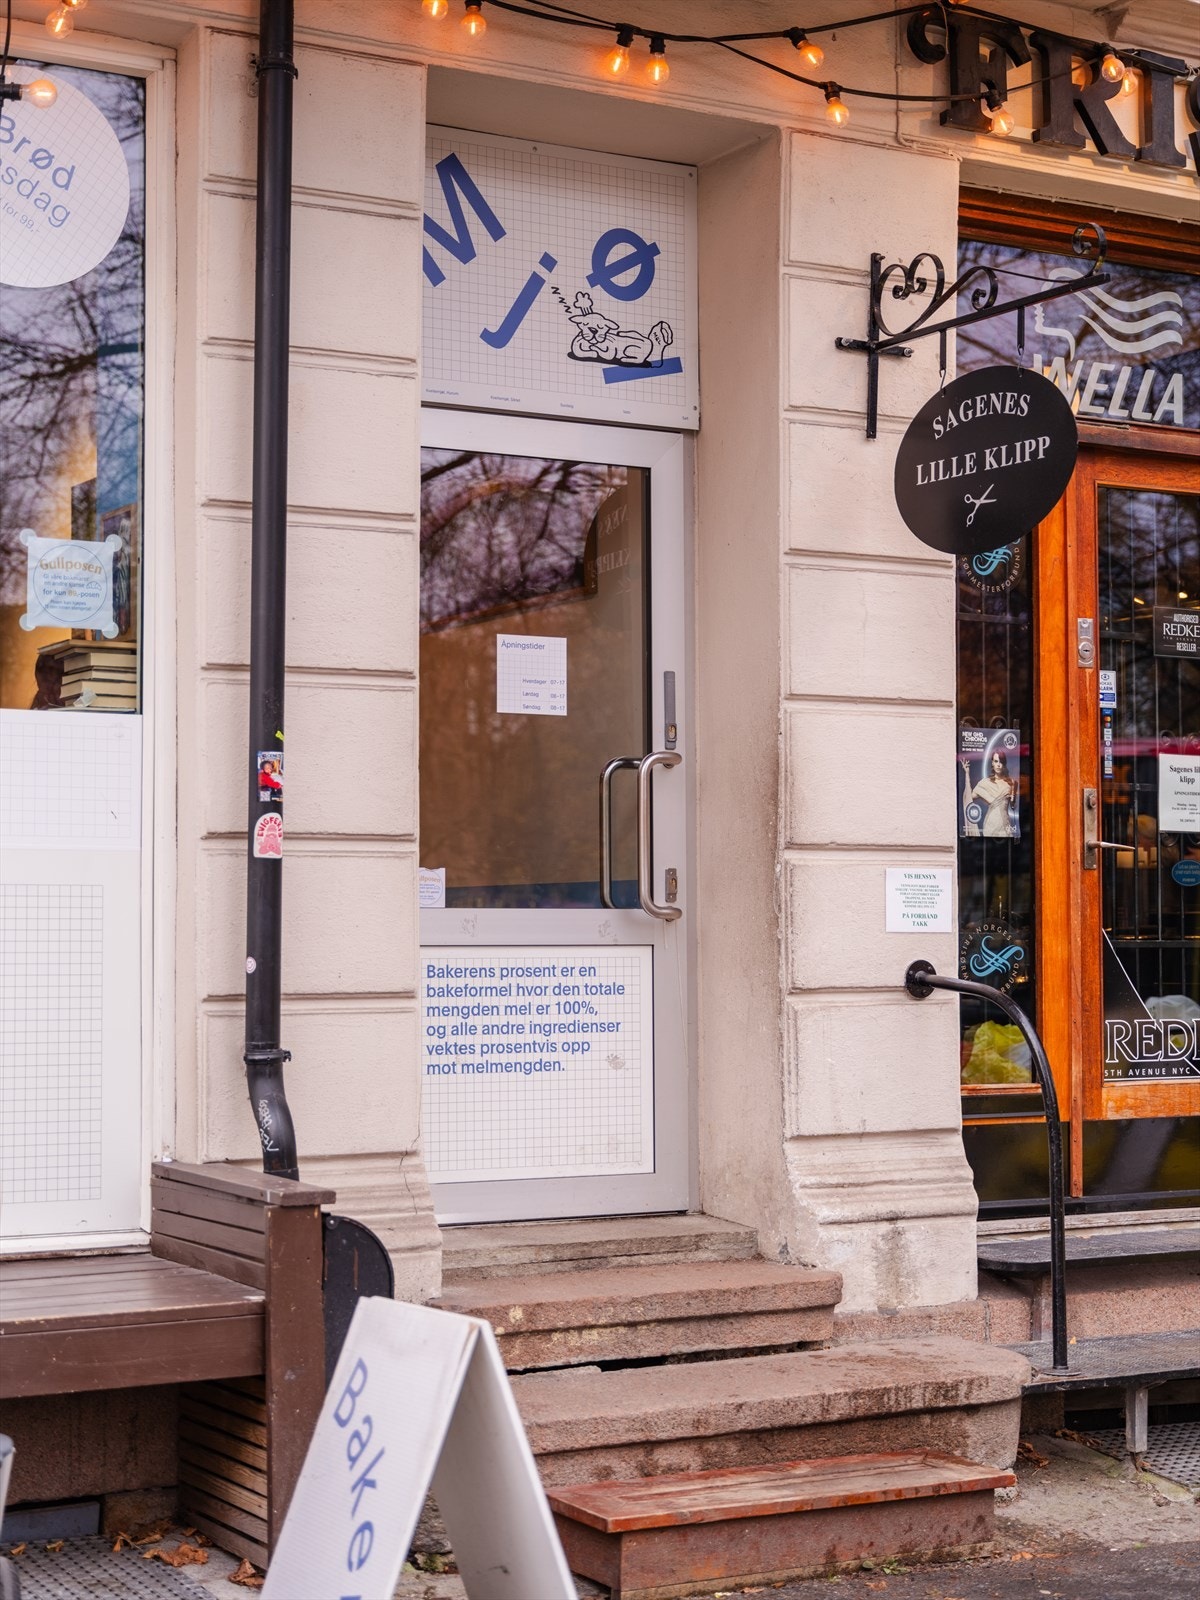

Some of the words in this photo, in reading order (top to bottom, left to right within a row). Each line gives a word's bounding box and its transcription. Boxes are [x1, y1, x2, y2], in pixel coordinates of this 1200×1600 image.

[0, 158, 70, 228] sdag
[1033, 354, 1184, 425] WELLA
[932, 391, 1031, 439] SAGENES
[915, 451, 977, 486] LILLE
[984, 435, 1051, 471] KLIPP
[40, 556, 102, 575] Gullposen
[1176, 642, 1197, 652] RESELLER
[1169, 765, 1193, 775] Sagenes
[1179, 775, 1196, 785] klipp
[911, 912, 938, 920] FORHÅND
[976, 924, 1013, 941] NORGES
[426, 964, 496, 979] Bakerens
[500, 963, 557, 981] prosent
[560, 965, 576, 977] er
[578, 965, 597, 977] en
[426, 982, 512, 998] bakeformel
[516, 982, 549, 997] hvor
[552, 981, 580, 996] den
[584, 981, 625, 996] totale
[426, 1002, 500, 1020] mengden
[504, 1001, 532, 1016] mel
[535, 1003, 551, 1015] er
[554, 1000, 599, 1017] 100%,
[426, 1022, 446, 1039] og
[450, 1021, 478, 1036] alle
[481, 1021, 525, 1036] andre
[529, 1020, 621, 1037] ingredienser
[426, 1040, 476, 1056] vektes
[480, 1039, 558, 1057] prosentvis
[561, 1040, 591, 1055] opp
[426, 1061, 457, 1075] mot
[461, 1058, 566, 1076] melmengden.
[1104, 1069, 1122, 1077] 5TH
[1128, 1067, 1166, 1076] AVENUE
[1172, 1066, 1191, 1075] NYC
[333, 1358, 386, 1600] Bake
